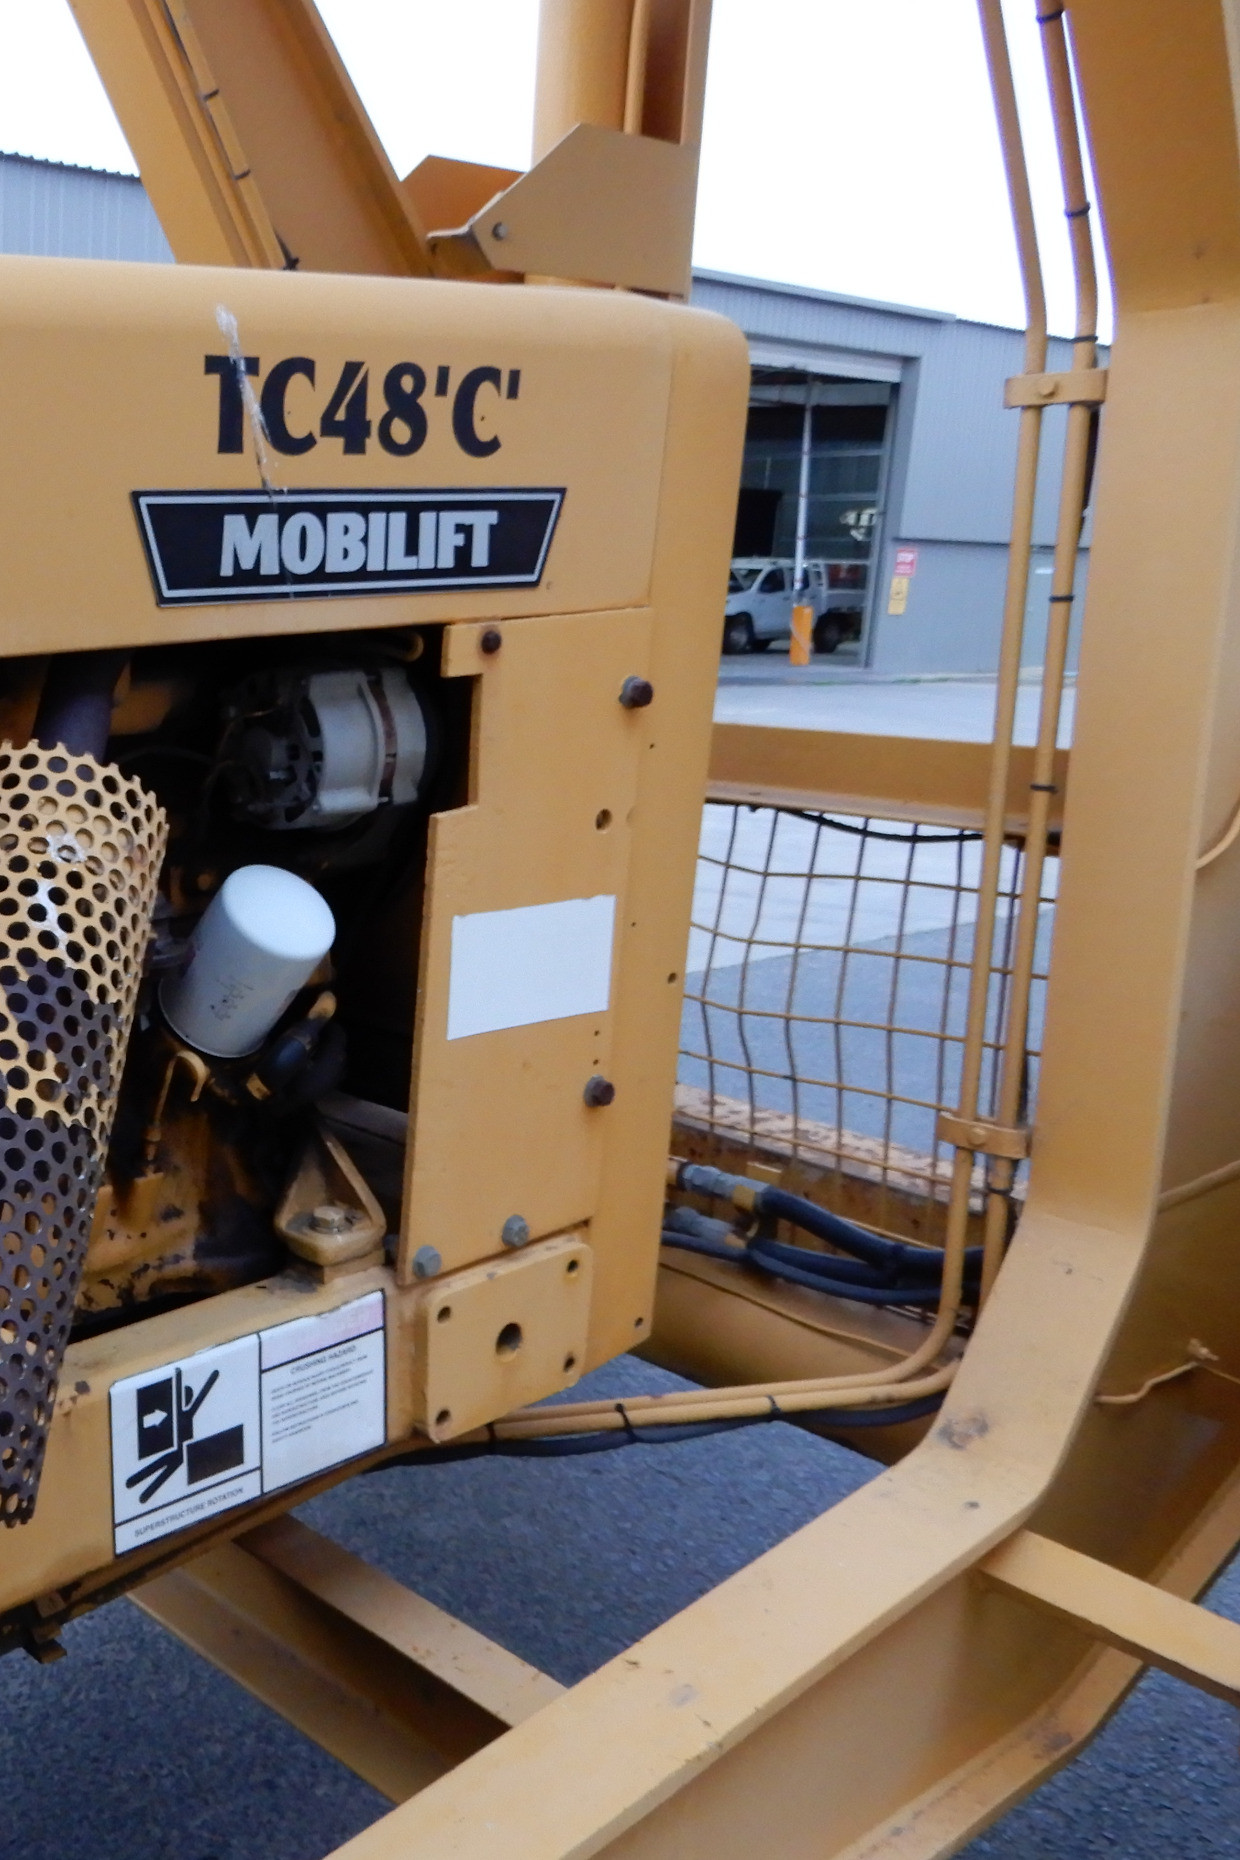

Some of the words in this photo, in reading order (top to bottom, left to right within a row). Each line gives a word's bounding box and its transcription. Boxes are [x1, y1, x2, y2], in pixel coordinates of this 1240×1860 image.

[204, 355, 521, 458] TC48'C'
[219, 510, 499, 577] MOBILIFT
[290, 1356, 327, 1375] CRUSHING
[328, 1345, 357, 1361] HAZARD
[134, 1503, 206, 1538] SUPERSTRUCTURE
[207, 1486, 244, 1509] ROTATION
